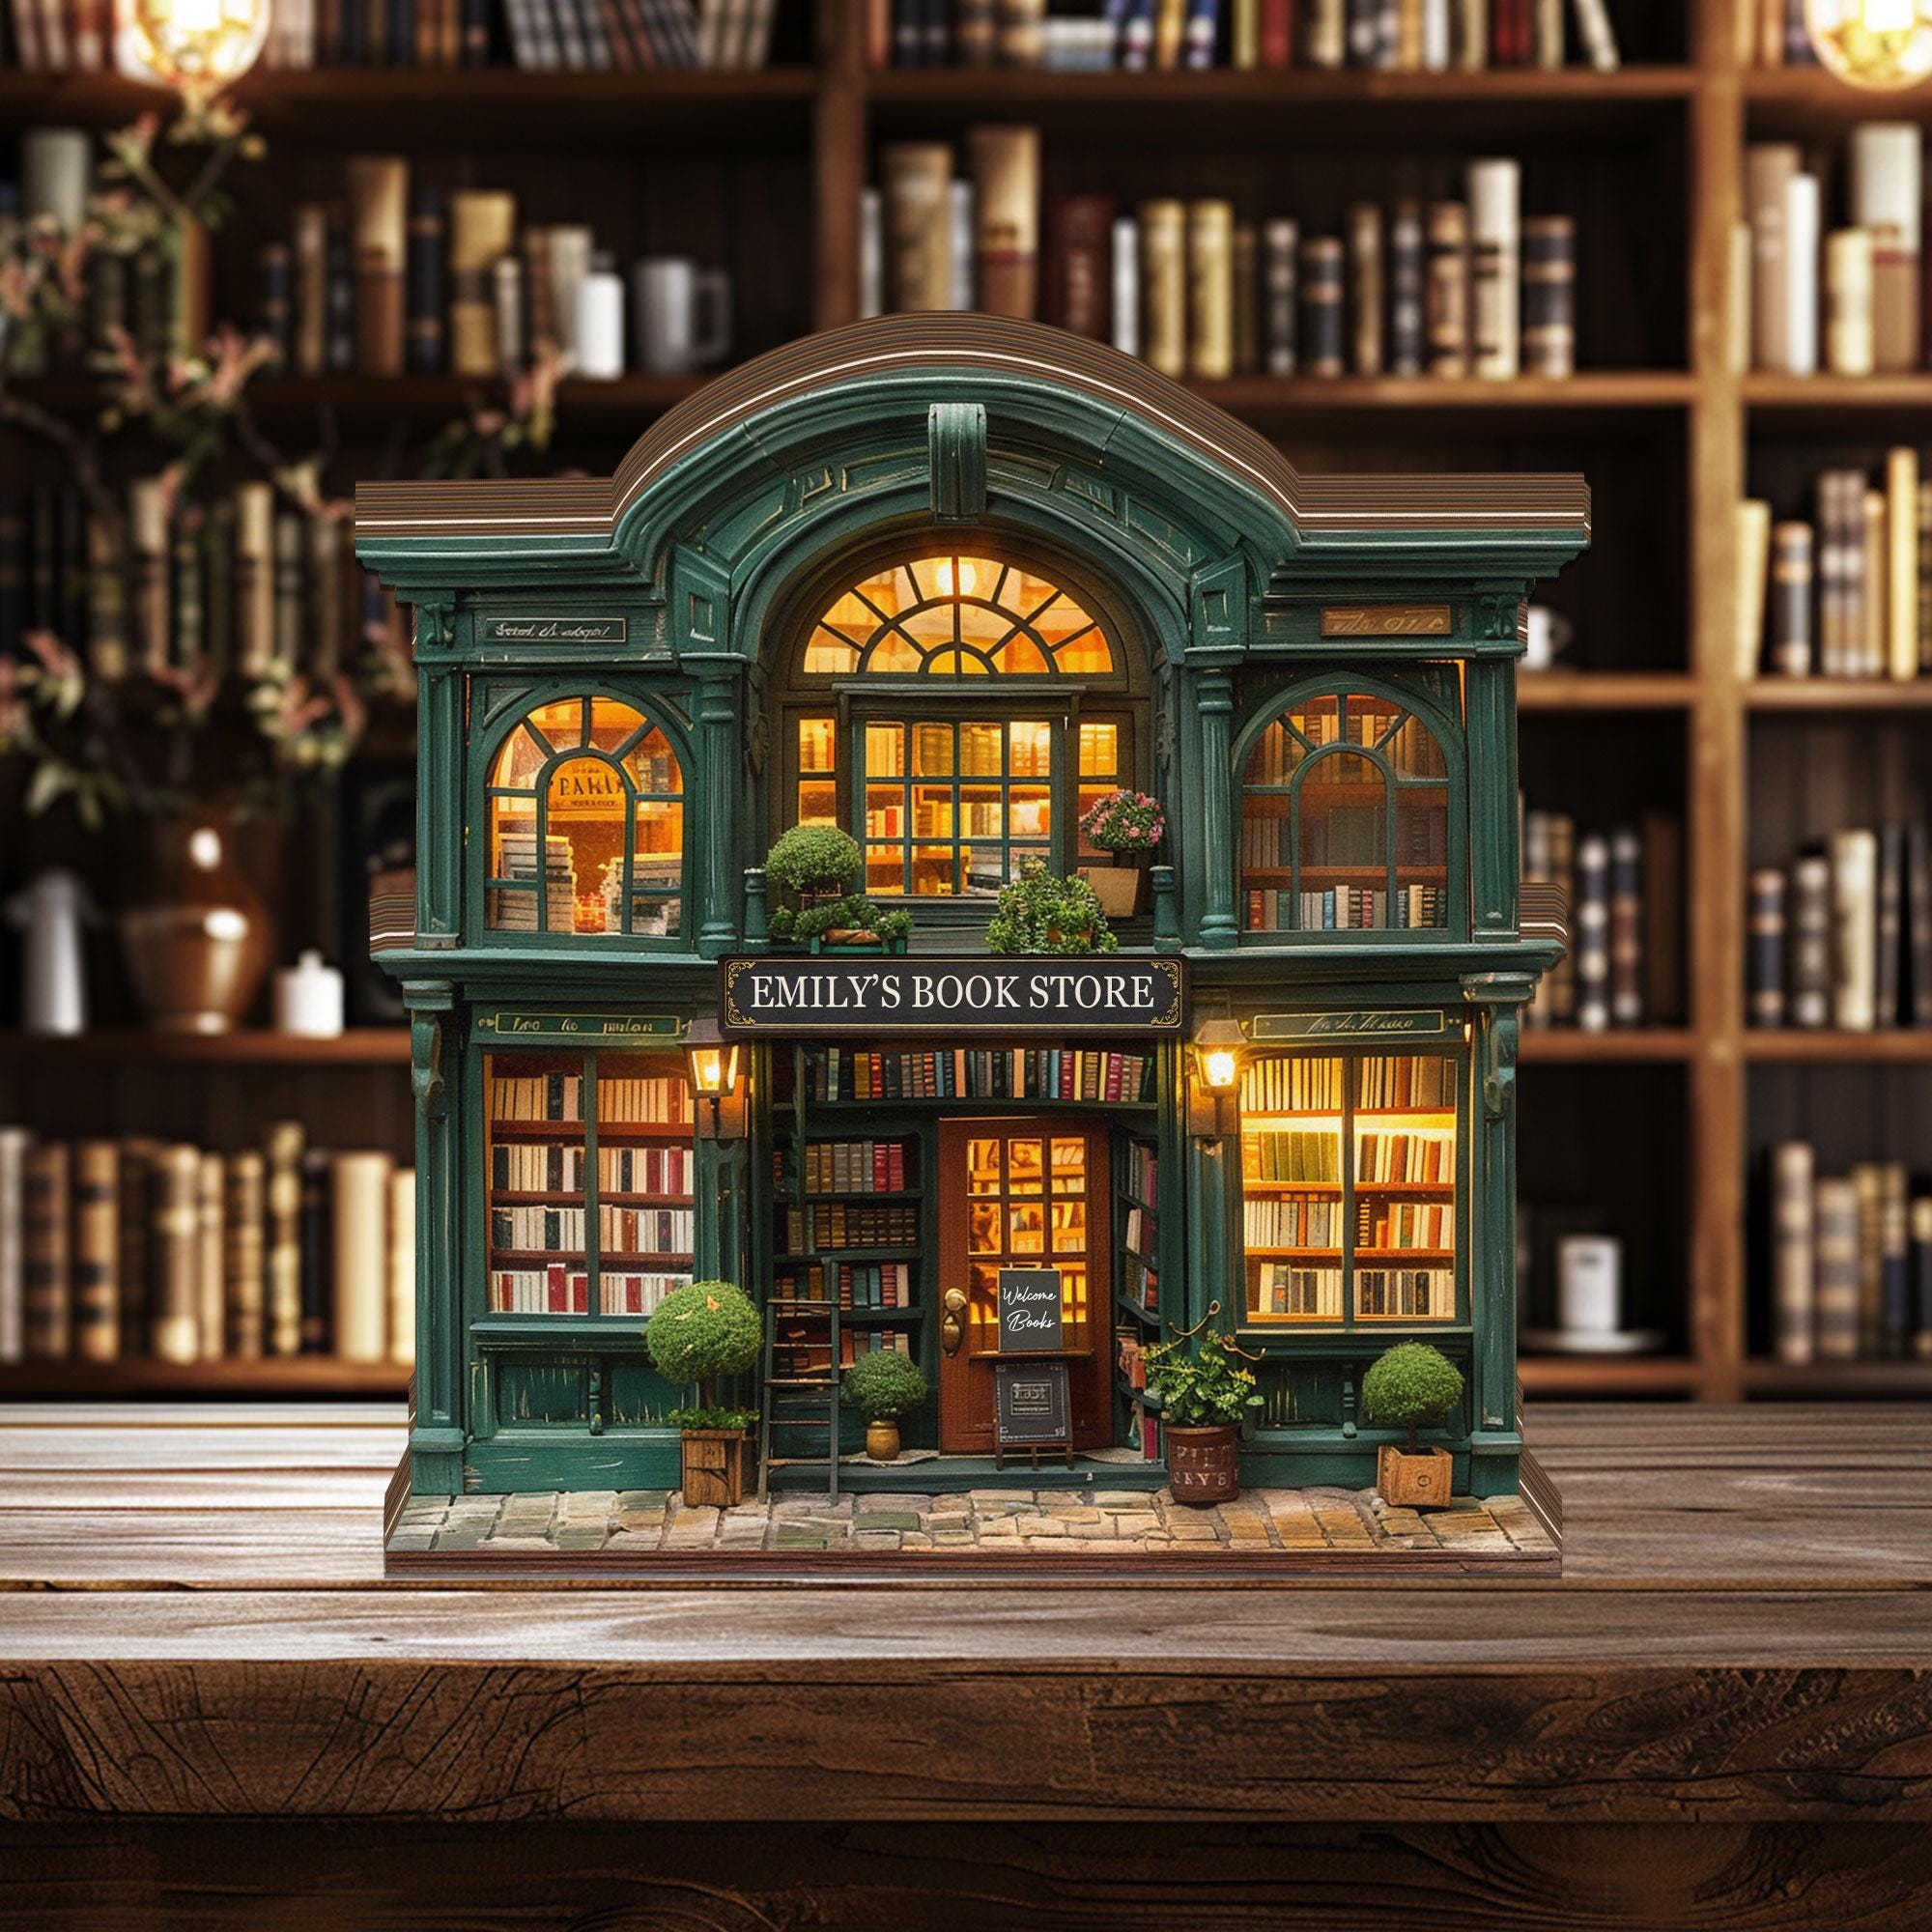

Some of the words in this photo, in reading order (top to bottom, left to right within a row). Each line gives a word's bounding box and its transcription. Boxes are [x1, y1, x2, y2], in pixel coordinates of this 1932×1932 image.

[751, 974, 901, 1009] EMILY'S
[911, 974, 1021, 1009] BOOK
[1029, 974, 1155, 1009] STORE
[1003, 1286, 1057, 1306] Welcome
[1007, 1309, 1056, 1332] Books
